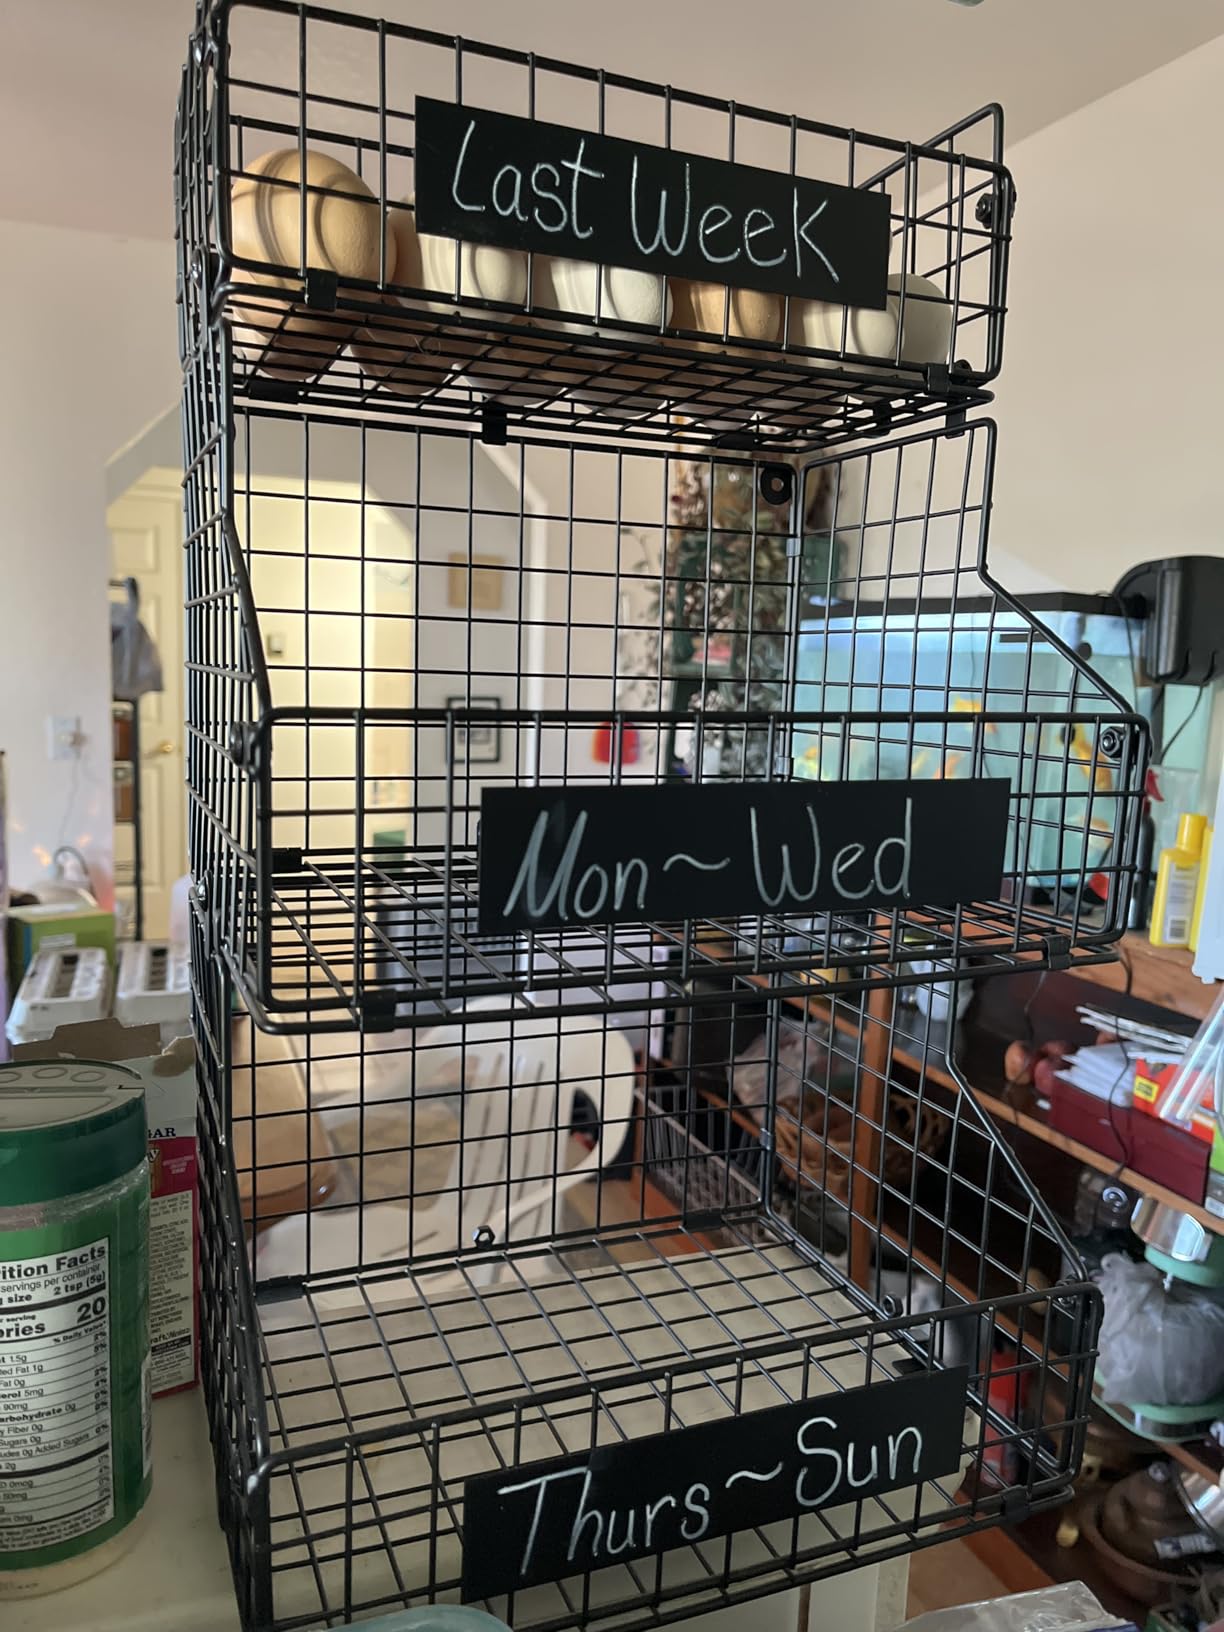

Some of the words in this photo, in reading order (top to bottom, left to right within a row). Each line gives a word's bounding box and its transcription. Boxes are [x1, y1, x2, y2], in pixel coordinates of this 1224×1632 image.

[452, 119, 605, 239] Last
[630, 154, 840, 283] Week
[0, 1263, 48, 1280] ition
[56, 1246, 106, 1271] Facts
[1, 1281, 42, 1293] servings
[44, 1277, 60, 1288] per
[62, 1263, 100, 1282] container
[7, 1293, 33, 1304] size
[53, 1286, 61, 1296] 2
[64, 1281, 83, 1294] tsp
[86, 1270, 106, 1288] (5g)
[77, 1296, 106, 1323] 20
[16, 1365, 30, 1374] Fat
[33, 1364, 44, 1373] 1g
[14, 1379, 26, 1388] 0g
[24, 1388, 44, 1397] 5mg
[7, 1426, 29, 1434] Fiber
